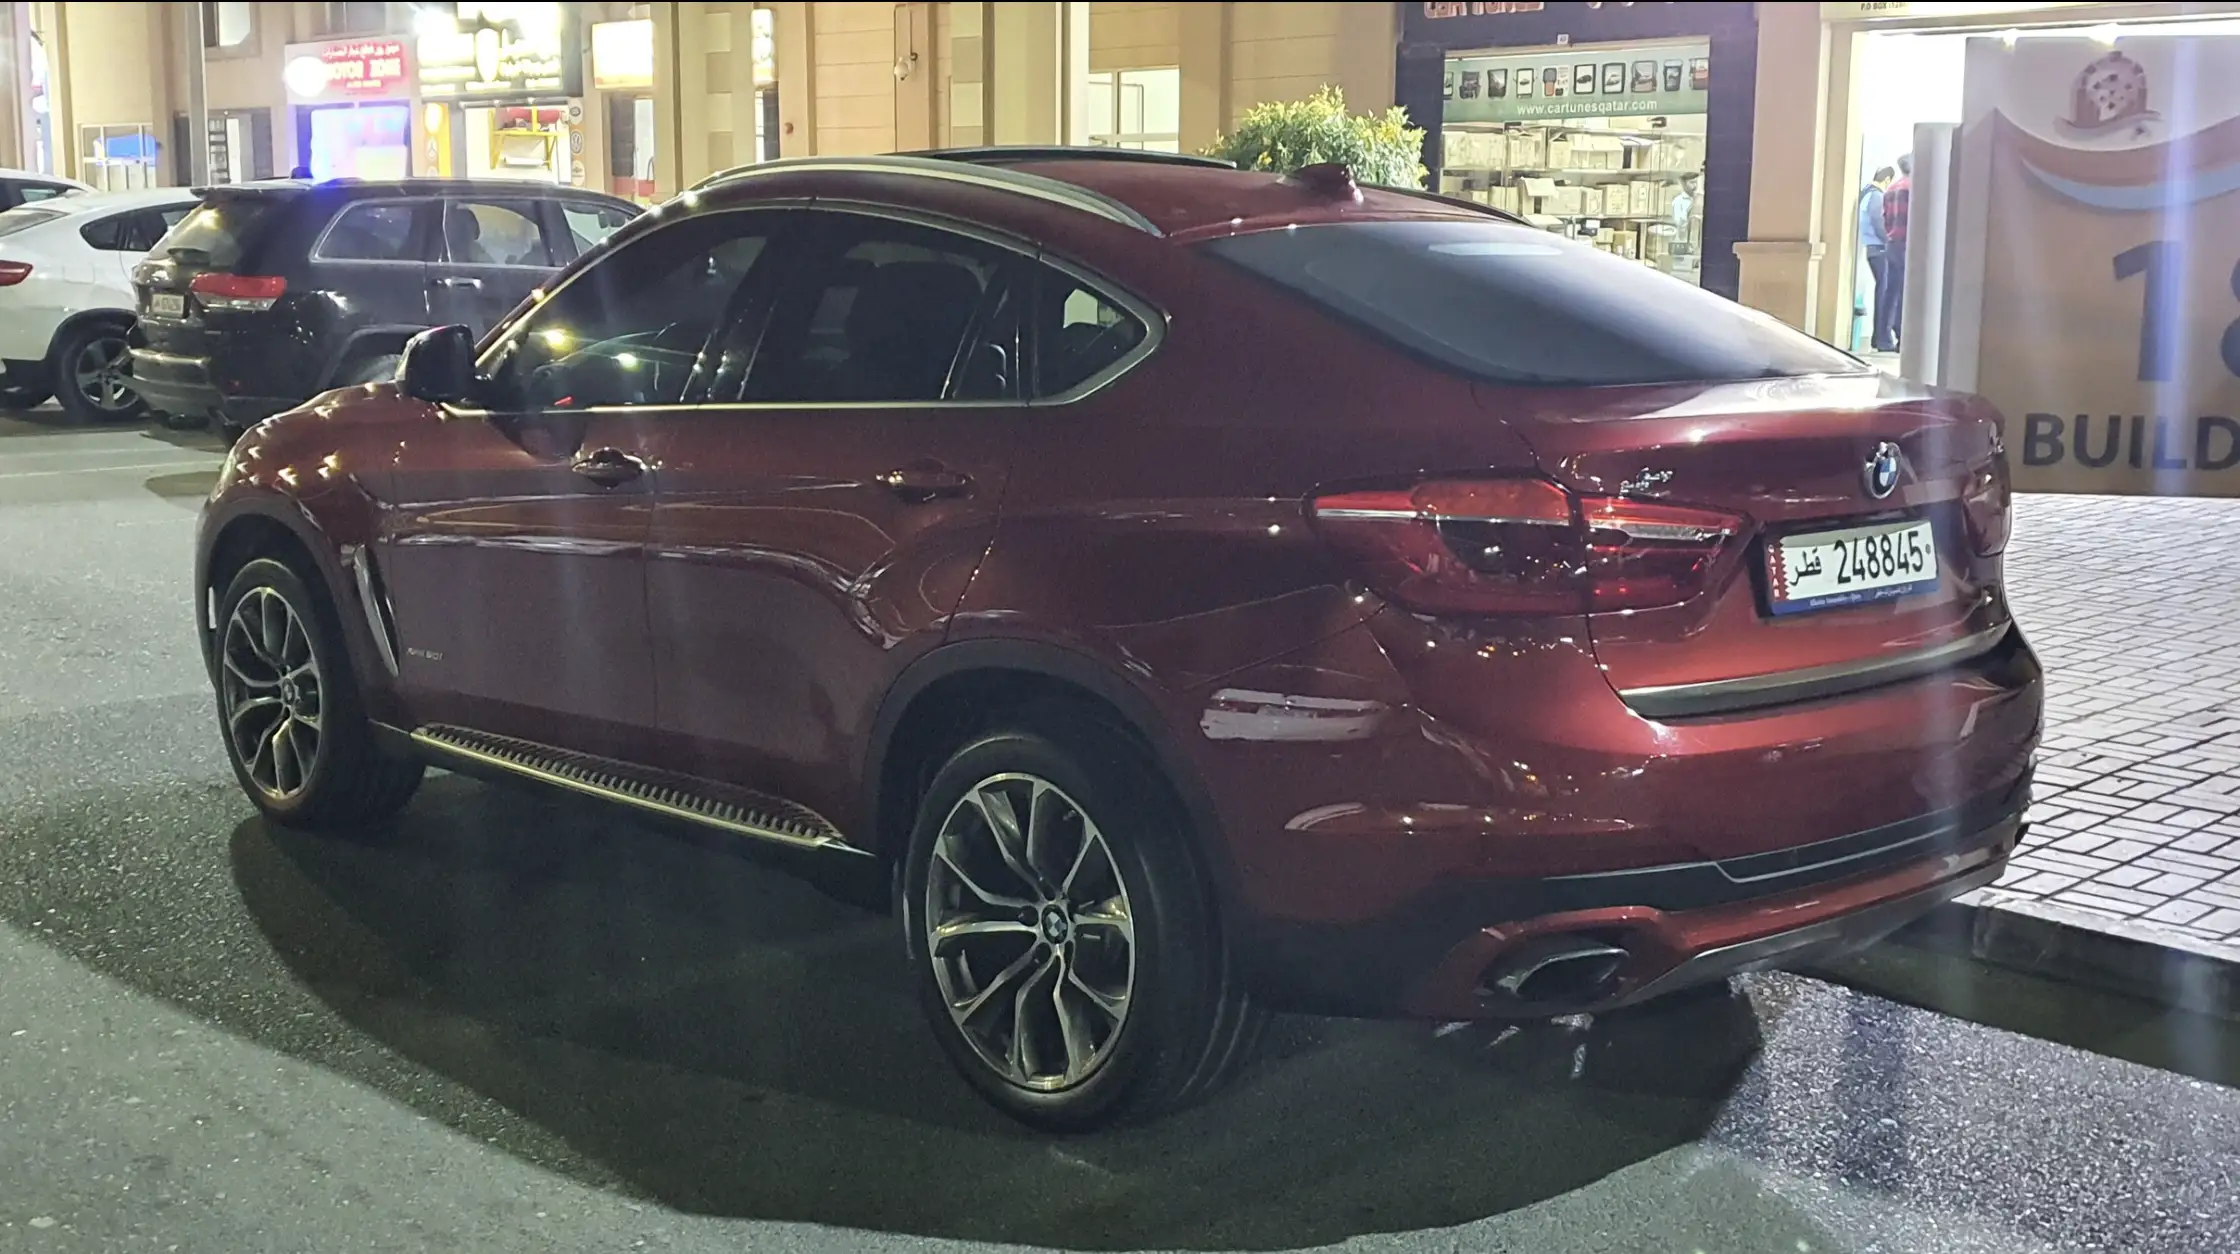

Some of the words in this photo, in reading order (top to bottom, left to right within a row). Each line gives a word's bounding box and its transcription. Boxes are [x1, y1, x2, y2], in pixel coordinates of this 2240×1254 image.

[1517, 99, 1658, 117] www.cartunesqatar.com
[1767, 544, 1781, 598] QATAR
[1789, 546, 1822, 586] قطر
[1833, 530, 1924, 585] 248845
